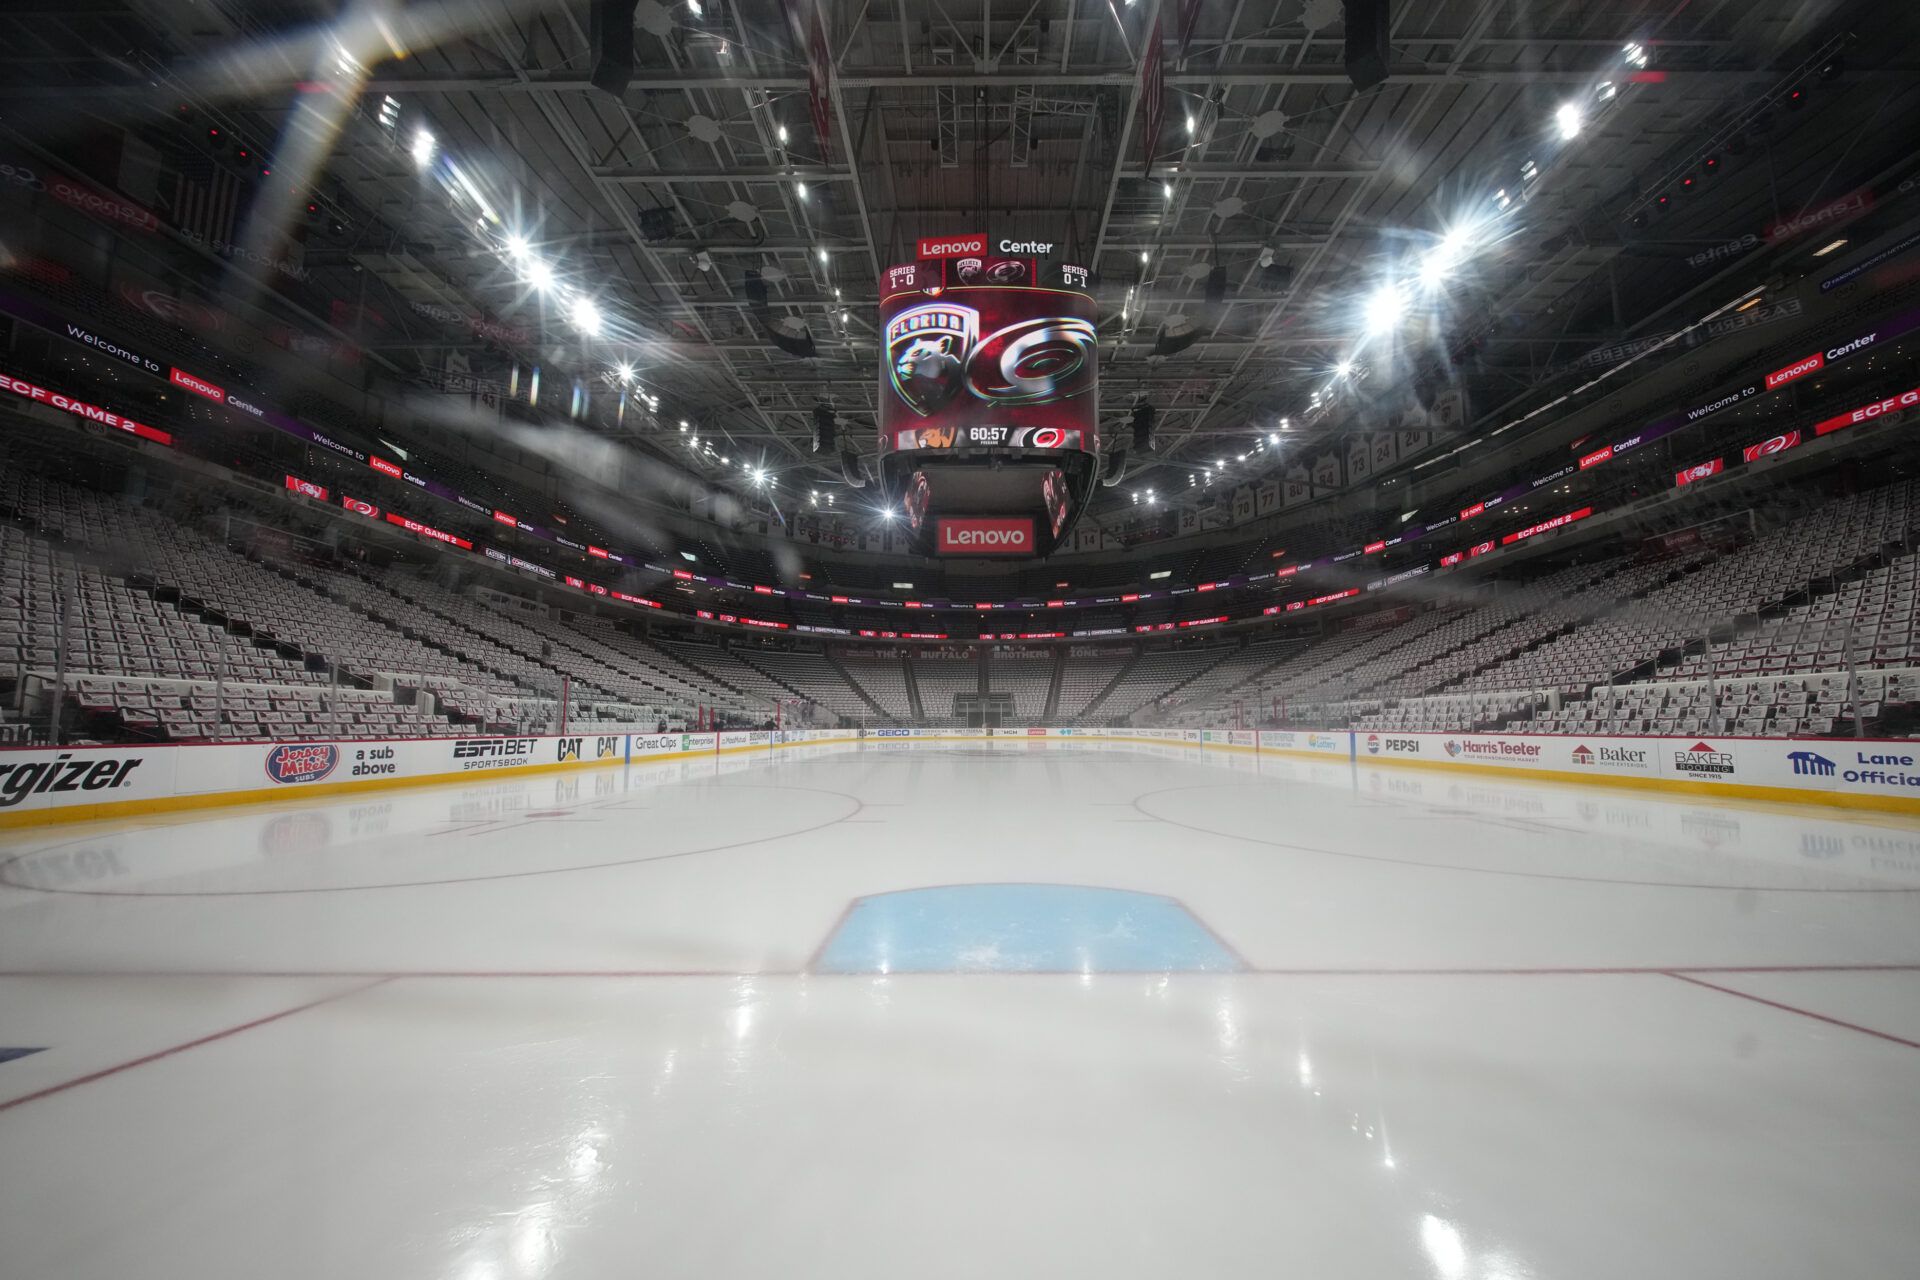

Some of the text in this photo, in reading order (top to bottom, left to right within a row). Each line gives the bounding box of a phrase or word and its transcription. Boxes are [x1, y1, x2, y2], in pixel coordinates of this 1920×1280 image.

[923, 239, 1053, 256] Lenovo Center
[889, 265, 916, 278] SERIES
[1062, 264, 1088, 277] SERIES
[891, 314, 961, 339] FLORIDA
[67, 323, 264, 417] Welcome to Lenovo Center
[1687, 332, 1878, 421] Welcome to Lenovo Center
[0, 375, 136, 433] ECF GAME 2
[1852, 391, 1920, 423] ECF G
[970, 427, 1008, 441] 60:57
[312, 431, 426, 487] Welcome to Lenovo Center
[1376, 444, 1390, 462] 24
[1532, 470, 1564, 488] Welcome
[1565, 465, 1574, 474] to
[1581, 449, 1610, 467] Lenovo
[1613, 435, 1642, 453] Center
[458, 495, 534, 533] Welcome to Lenovo Center
[1426, 496, 1503, 532] Welcome to Lenovo Center
[405, 520, 457, 544] ECF GAME 2
[946, 526, 1025, 545] Lenovo
[1517, 515, 1572, 539] ECF GAME 2
[556, 535, 579, 550] Welcome
[608, 553, 623, 562] Center
[1333, 551, 1355, 562] Welcome
[1385, 536, 1402, 546] Center
[876, 649, 897, 658] THE
[921, 651, 969, 659] BUFFALO
[993, 650, 1050, 659] BROTHERS
[1070, 649, 1099, 658] ZONE
[877, 729, 910, 737] GEICO
[558, 738, 583, 762] CAT
[597, 736, 618, 758] CAT
[635, 736, 677, 750] Great Clips
[1386, 739, 1419, 752] PEPSI
[1463, 740, 1541, 756] Harris Teeter
[277, 745, 331, 763] Jersey
[356, 746, 395, 760] a sub
[1600, 747, 1646, 762] Baker
[1674, 751, 1733, 765] BAKER
[1857, 752, 1914, 766] Lane
[280, 756, 328, 777] Mike's
[352, 762, 396, 776] above
[463, 759, 528, 770] SPORTSBOOK
[1679, 764, 1730, 773] ROOFING
[294, 773, 316, 783] SUBS
[1843, 770, 1920, 787] Officia
